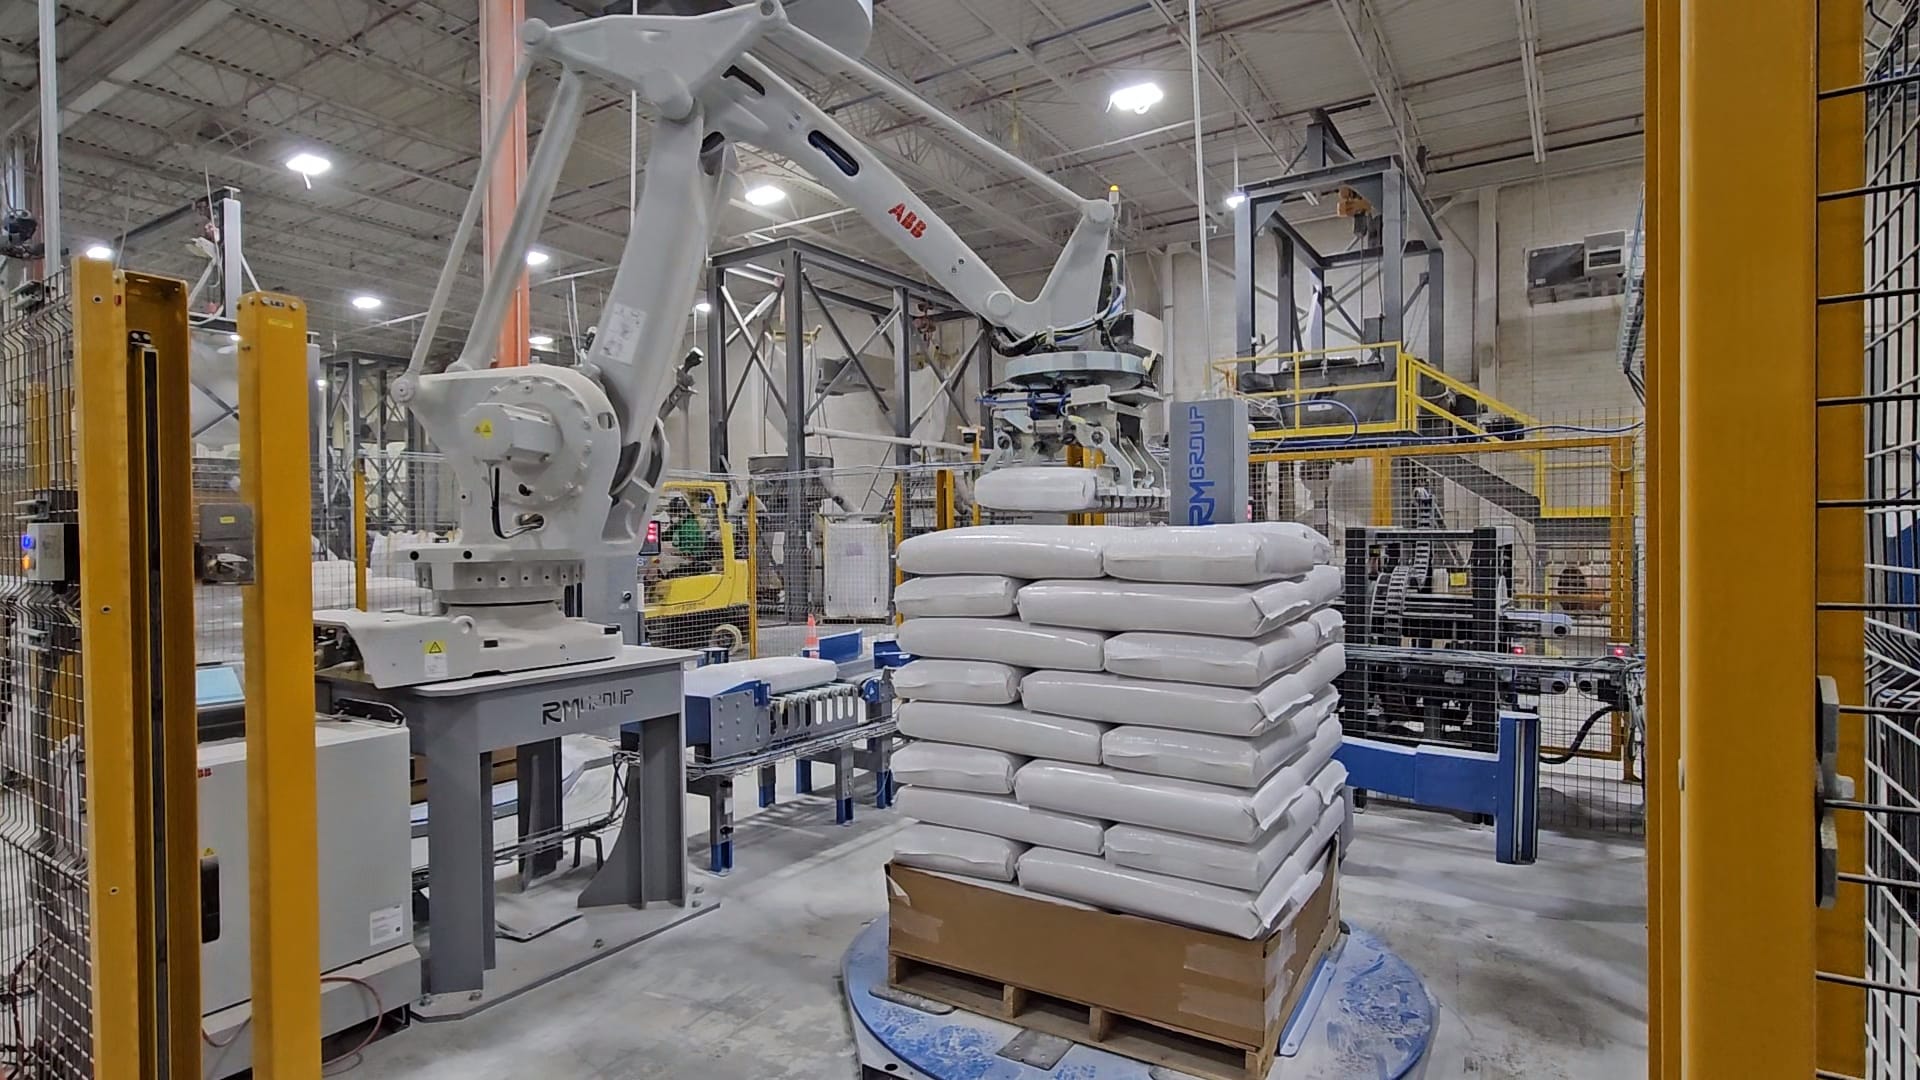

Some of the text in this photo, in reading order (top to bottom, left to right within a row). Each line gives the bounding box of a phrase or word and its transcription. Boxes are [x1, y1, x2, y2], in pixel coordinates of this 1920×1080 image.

[887, 203, 927, 238] ABB
[1189, 406, 1215, 526] RMGROUP
[542, 689, 634, 725] RMOUP
[197, 767, 212, 778] BB
